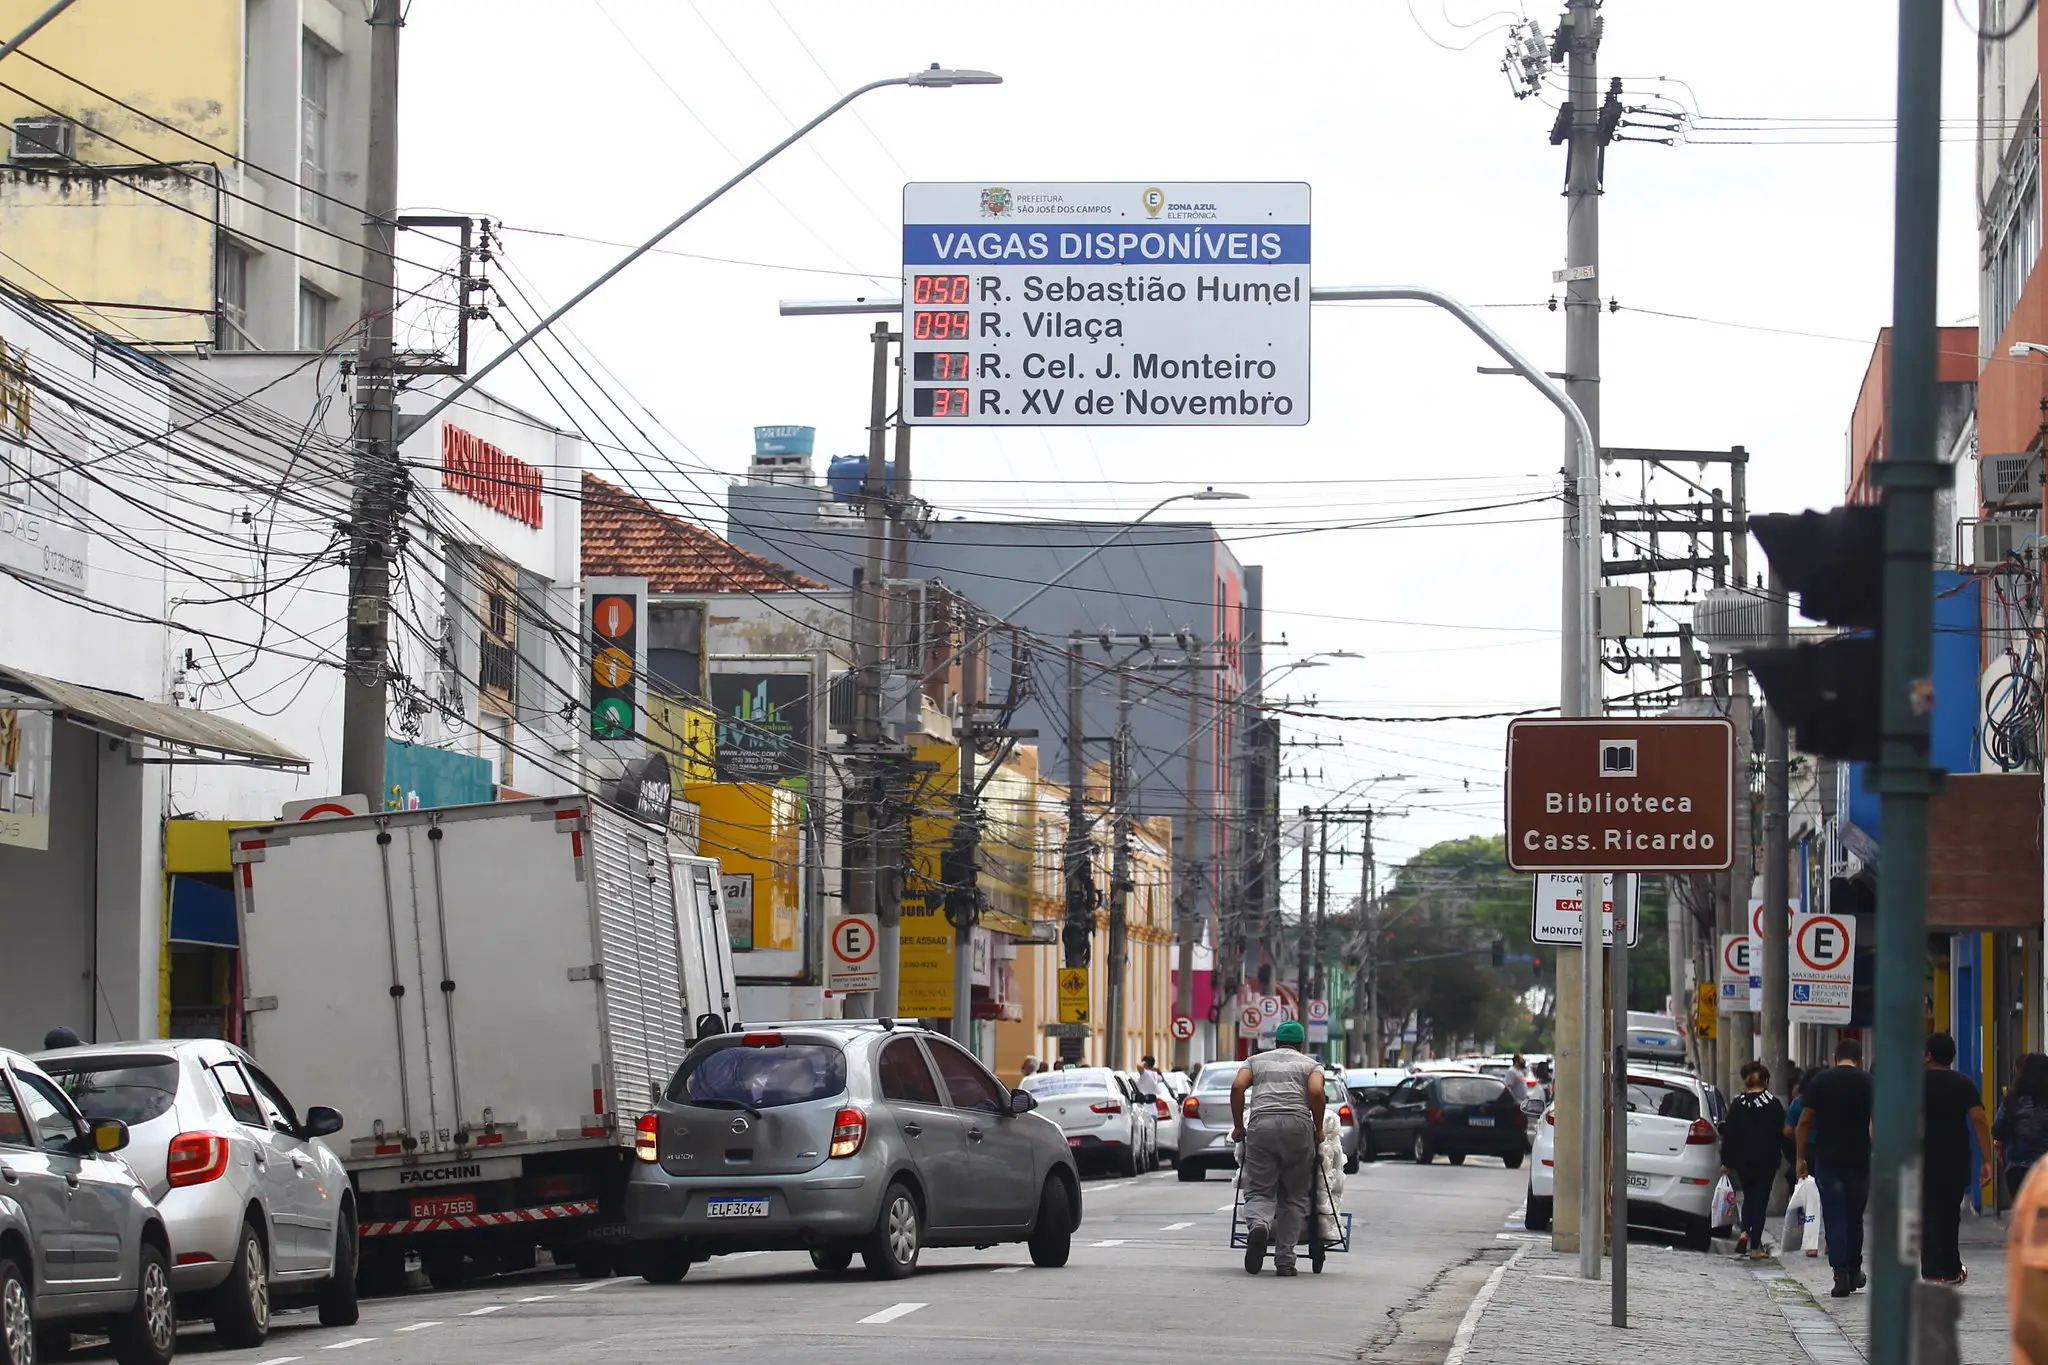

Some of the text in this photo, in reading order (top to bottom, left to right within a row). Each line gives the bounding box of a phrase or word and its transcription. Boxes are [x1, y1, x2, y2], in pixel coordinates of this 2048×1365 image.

[1017, 195, 1063, 203] PREFEITURA
[1017, 204, 1112, 214] SÃO JOSÉ DOS CAMPOS
[1167, 203, 1217, 211] ZONA AZUL
[1167, 211, 1217, 220] ELETRÔNICA
[932, 226, 1282, 260] VAGAS DISPONÍVEIS
[915, 276, 968, 304] 050
[980, 276, 1300, 303] R. Sebastião Humel
[915, 312, 969, 340] 094
[980, 312, 1124, 344] R. Vilaça
[937, 353, 969, 381] 71
[980, 353, 1277, 380] R. Cel. J. Monteiro
[933, 388, 969, 416] 37
[980, 389, 1293, 416] R. XV de Novembro
[443, 421, 543, 530] RESTAURANTE
[0, 511, 40, 542] DAS
[1545, 792, 1692, 814] Biblioteca
[1523, 829, 1715, 851] Cass. Ricardo
[847, 928, 861, 953] E
[1813, 928, 1834, 959] E
[1811, 983, 1849, 991] EXCLUSIVO
[1811, 990, 1849, 999] DEFICIENTE
[1265, 1001, 1272, 1012] E
[1314, 1004, 1321, 1014] E
[400, 1164, 481, 1184] FACCHINI
[711, 1203, 762, 1216] ELF3C64
